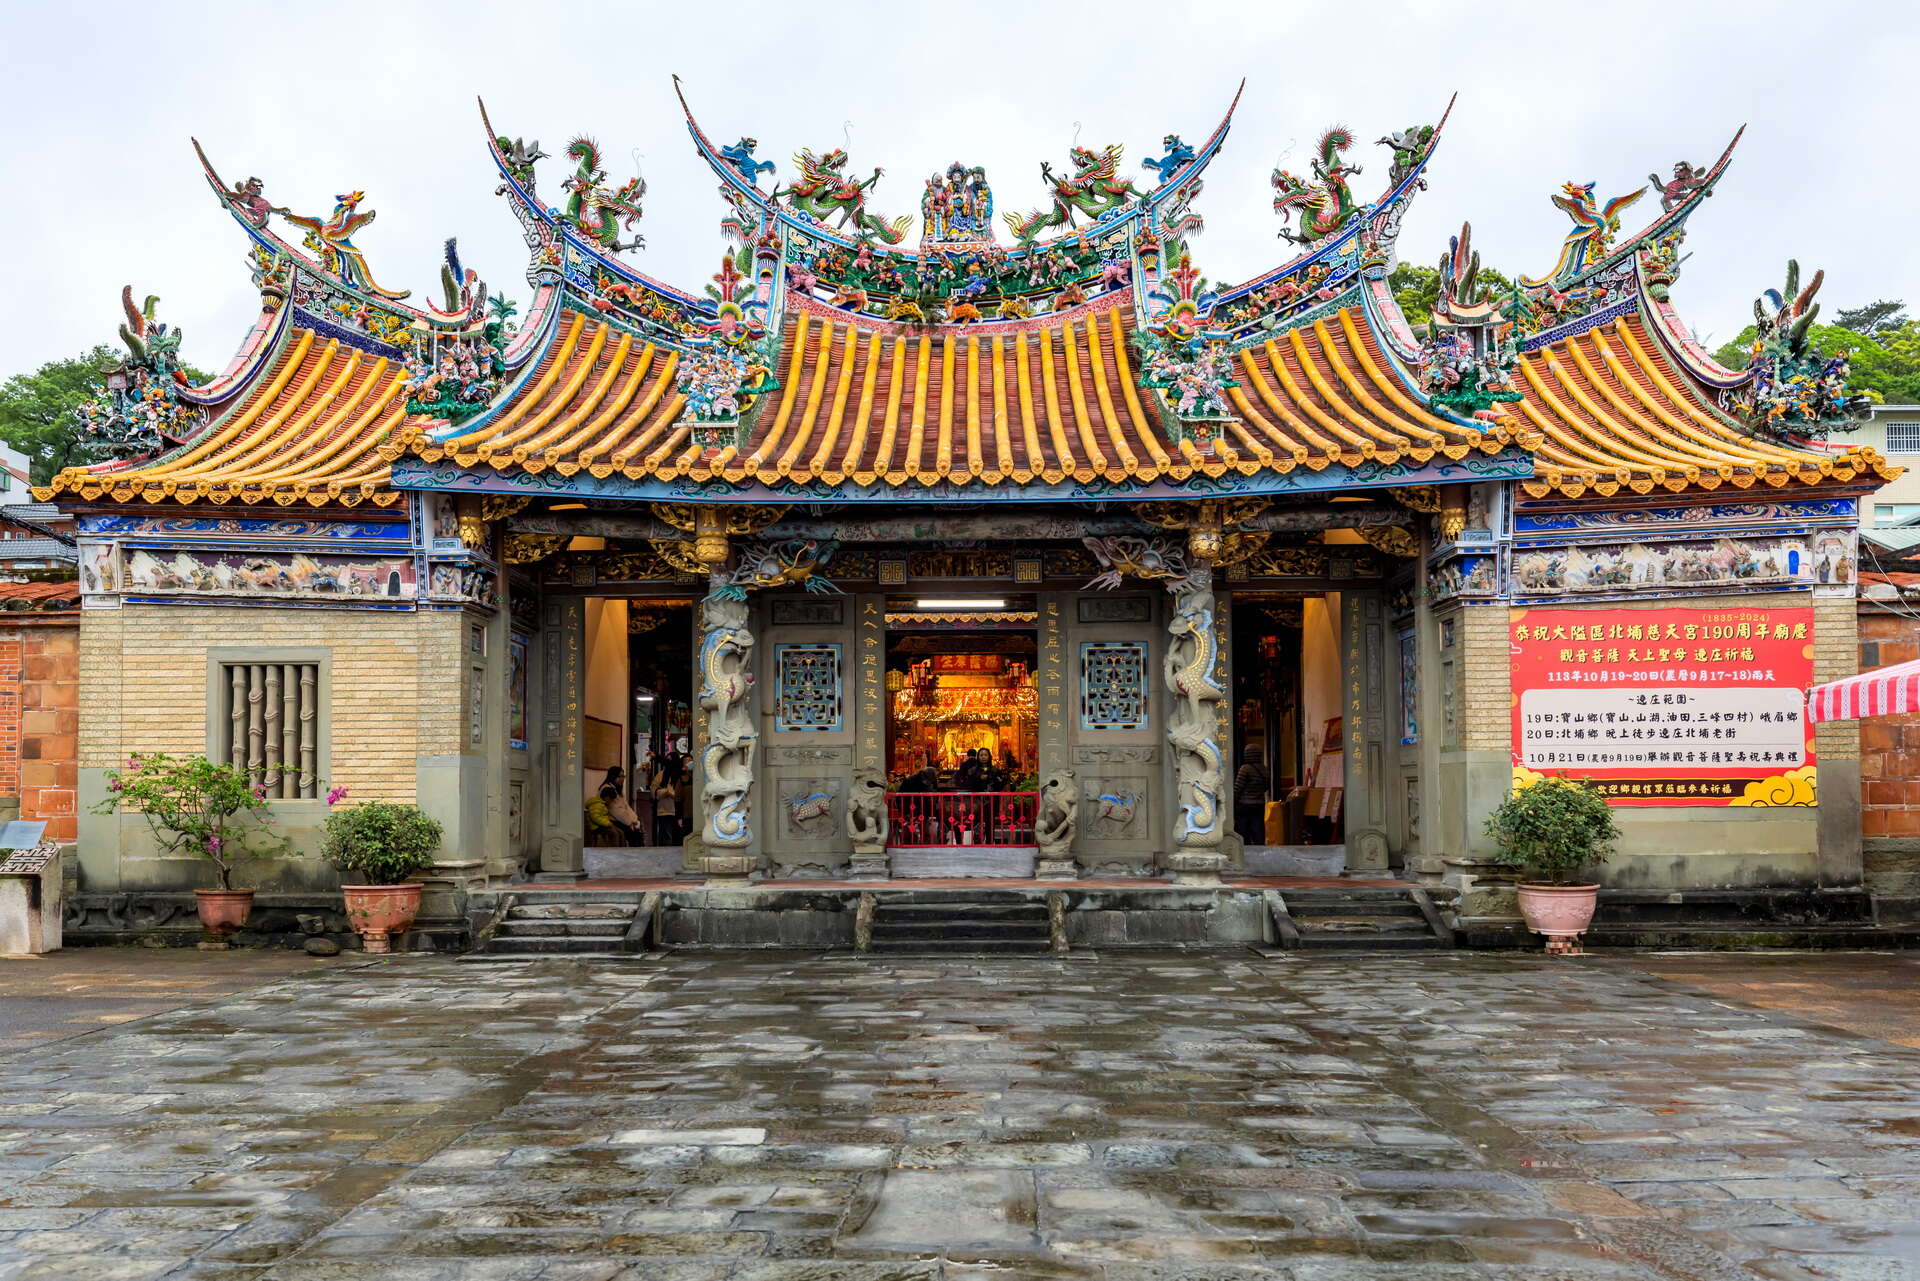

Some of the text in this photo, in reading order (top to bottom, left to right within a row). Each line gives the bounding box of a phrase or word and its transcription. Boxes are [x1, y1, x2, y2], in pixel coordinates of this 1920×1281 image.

[1702, 613, 1770, 622] (1835~2024)
[1515, 623, 1808, 641] 恭祝大隘區北埔慈天宮190周年廟慶
[1560, 647, 1755, 663] 觀音菩薩 天上聖母 遶庄祈福
[1527, 729, 1599, 740] 20日:北埔鄉
